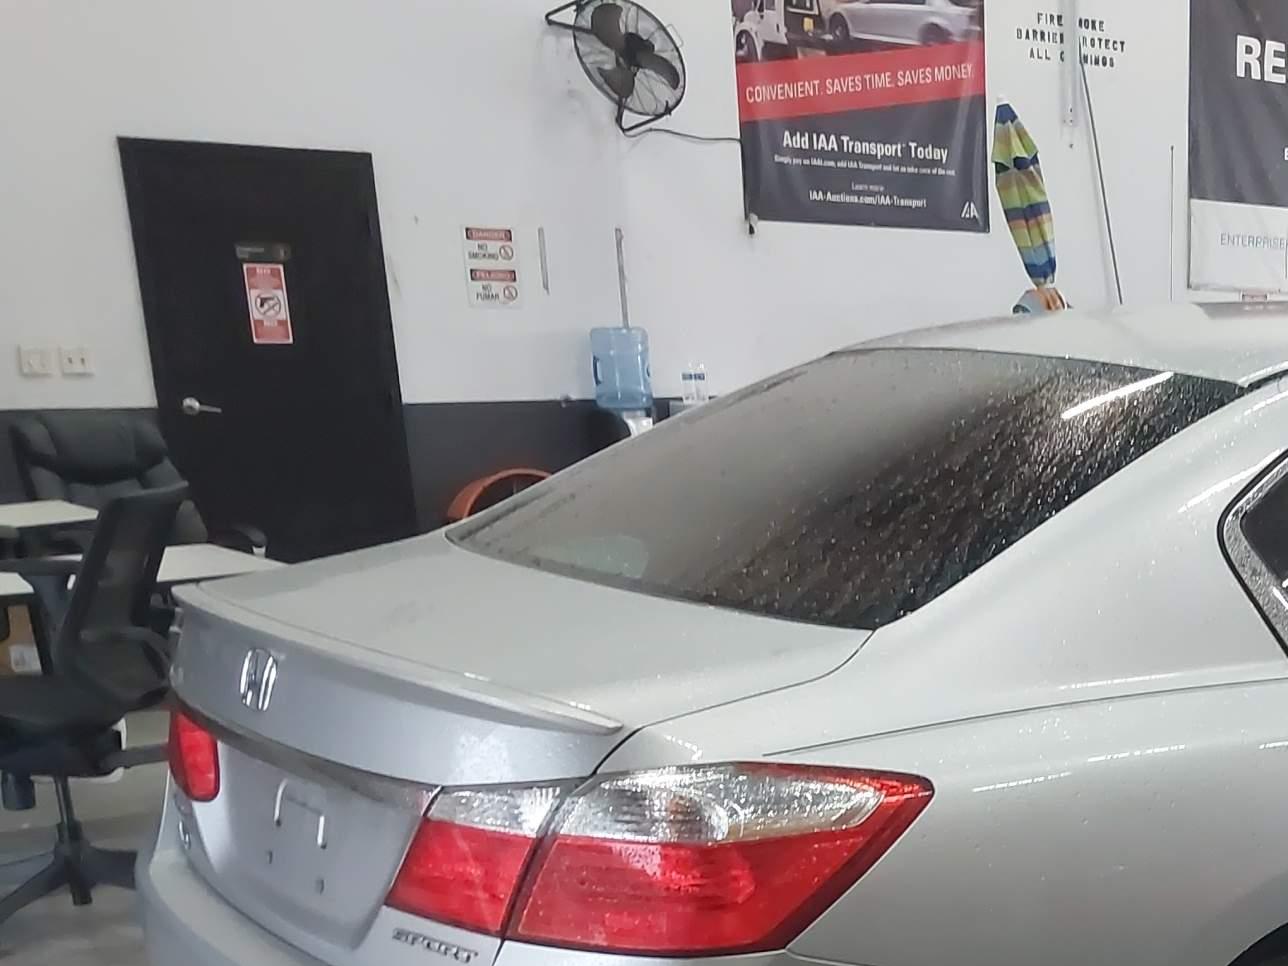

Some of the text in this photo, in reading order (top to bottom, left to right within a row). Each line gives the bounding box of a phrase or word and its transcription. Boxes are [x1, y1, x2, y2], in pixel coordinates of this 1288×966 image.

[1029, 47, 1051, 61] ALL
[1082, 36, 1126, 53] ROTECT
[745, 79, 823, 104] CONVENIENT.
[826, 75, 863, 95] SAVES
[897, 69, 932, 88] SAVES
[783, 130, 949, 165] Add IAA Transport Today
[392, 927, 479, 964] SPORT
